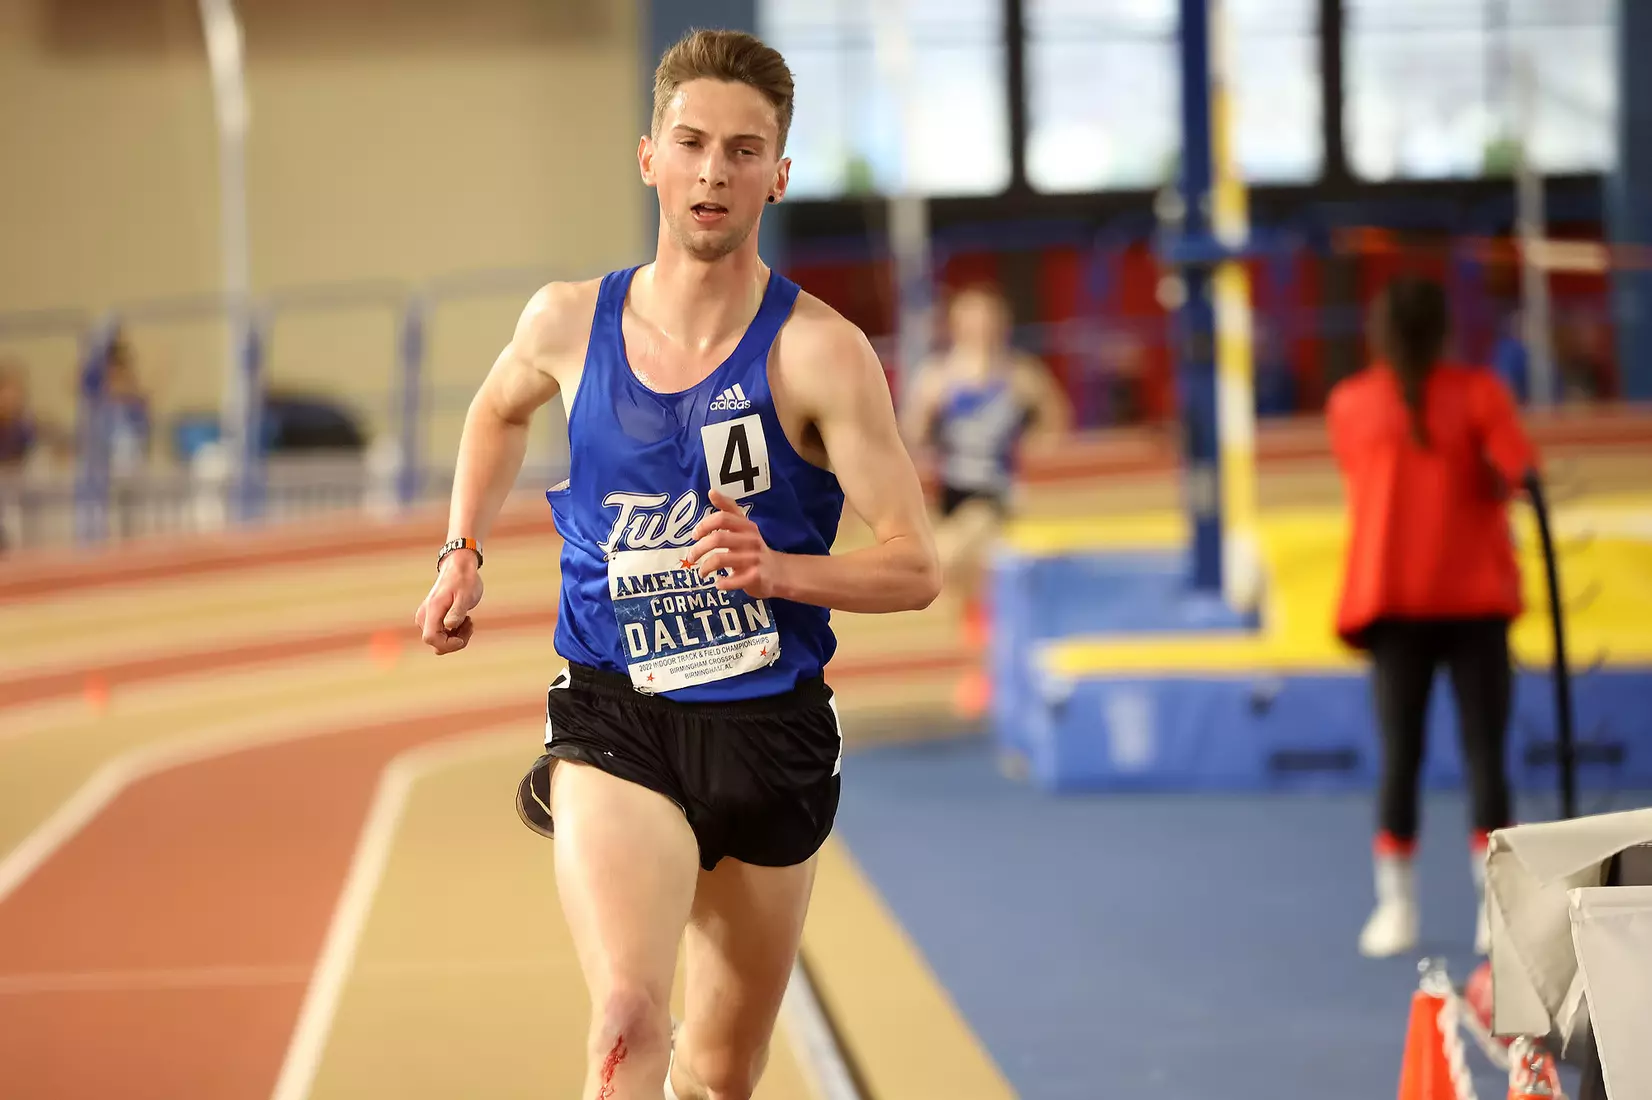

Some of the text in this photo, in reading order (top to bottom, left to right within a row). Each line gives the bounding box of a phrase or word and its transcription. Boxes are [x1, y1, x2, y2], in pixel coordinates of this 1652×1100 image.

[710, 399, 751, 411] adidas
[719, 423, 760, 493] 4
[597, 489, 754, 554] Tul
[650, 590, 730, 617] CORMAC
[624, 600, 771, 658] DALTON
[639, 662, 653, 672] 2022
[653, 657, 676, 668] INDOOR
[677, 651, 698, 662] TRACK
[704, 646, 722, 656] FIELD
[722, 637, 770, 653] CHAMPIONSHIPS
[669, 652, 744, 675] BIRMINGHAM CROSSPLEX
[725, 663, 733, 671] AL
